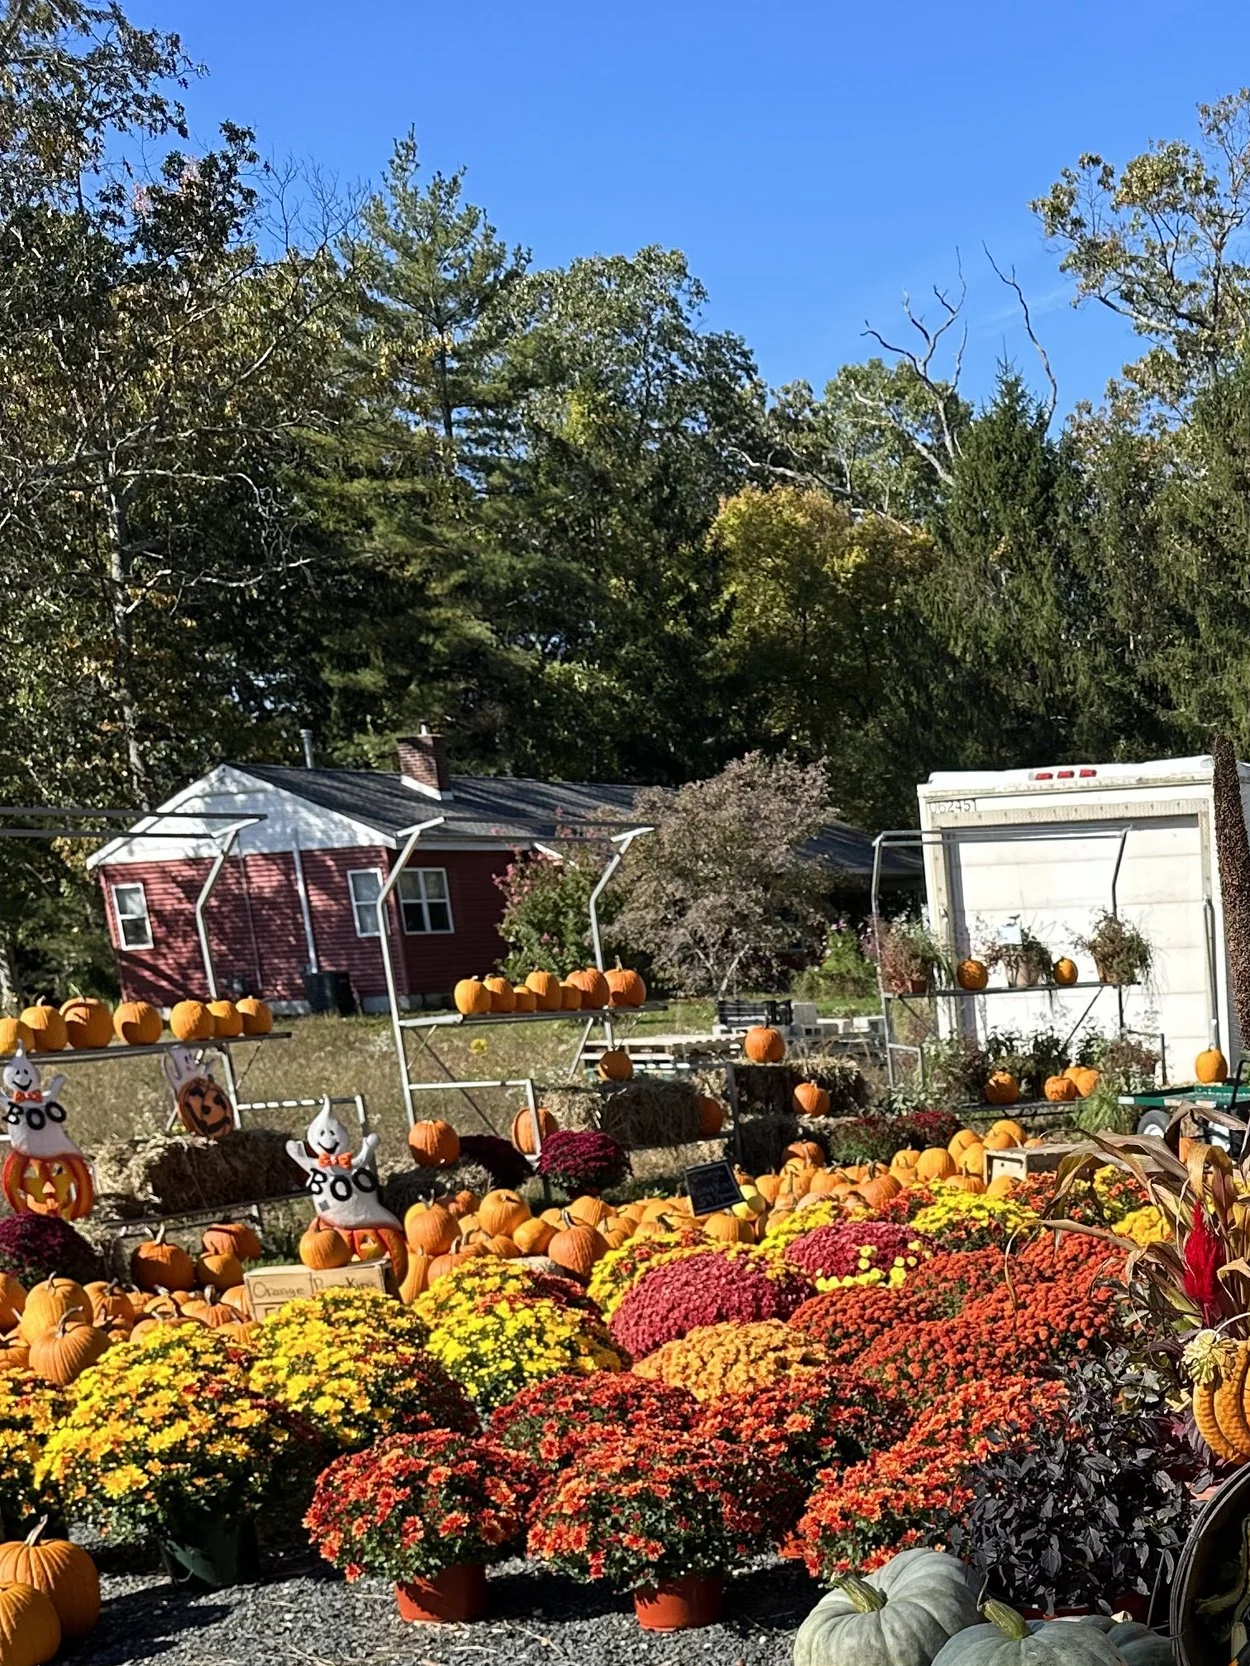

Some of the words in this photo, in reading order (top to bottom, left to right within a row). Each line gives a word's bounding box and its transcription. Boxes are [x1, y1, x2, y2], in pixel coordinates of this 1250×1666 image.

[2, 1101, 67, 1131] BOO
[310, 1167, 378, 1202] BOO
[253, 1281, 305, 1298] Orange
